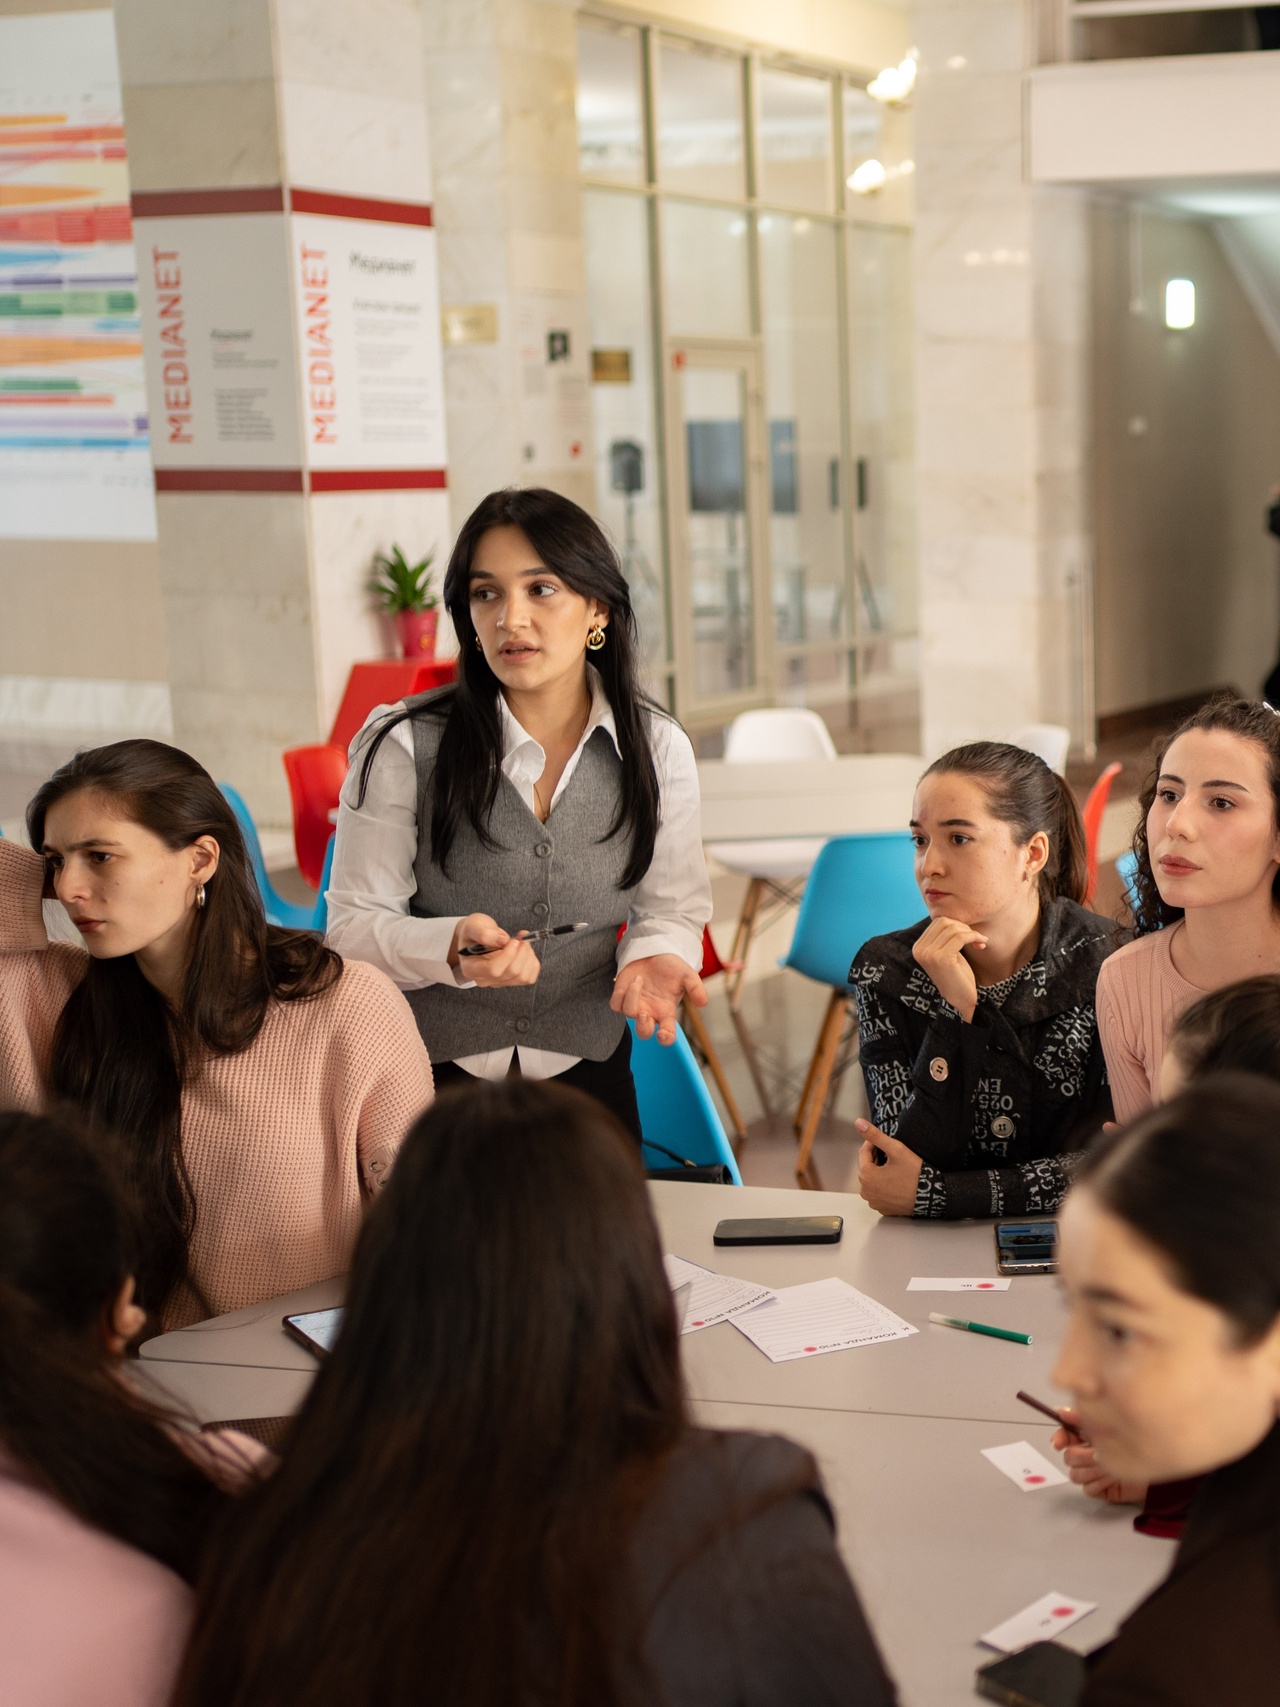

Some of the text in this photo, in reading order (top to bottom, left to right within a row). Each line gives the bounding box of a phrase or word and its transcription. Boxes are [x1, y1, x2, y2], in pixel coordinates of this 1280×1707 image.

[153, 245, 194, 444] MEDIANET
[302, 242, 339, 444] MEDIANET
[843, 1331, 897, 1345] КОМАНДА
